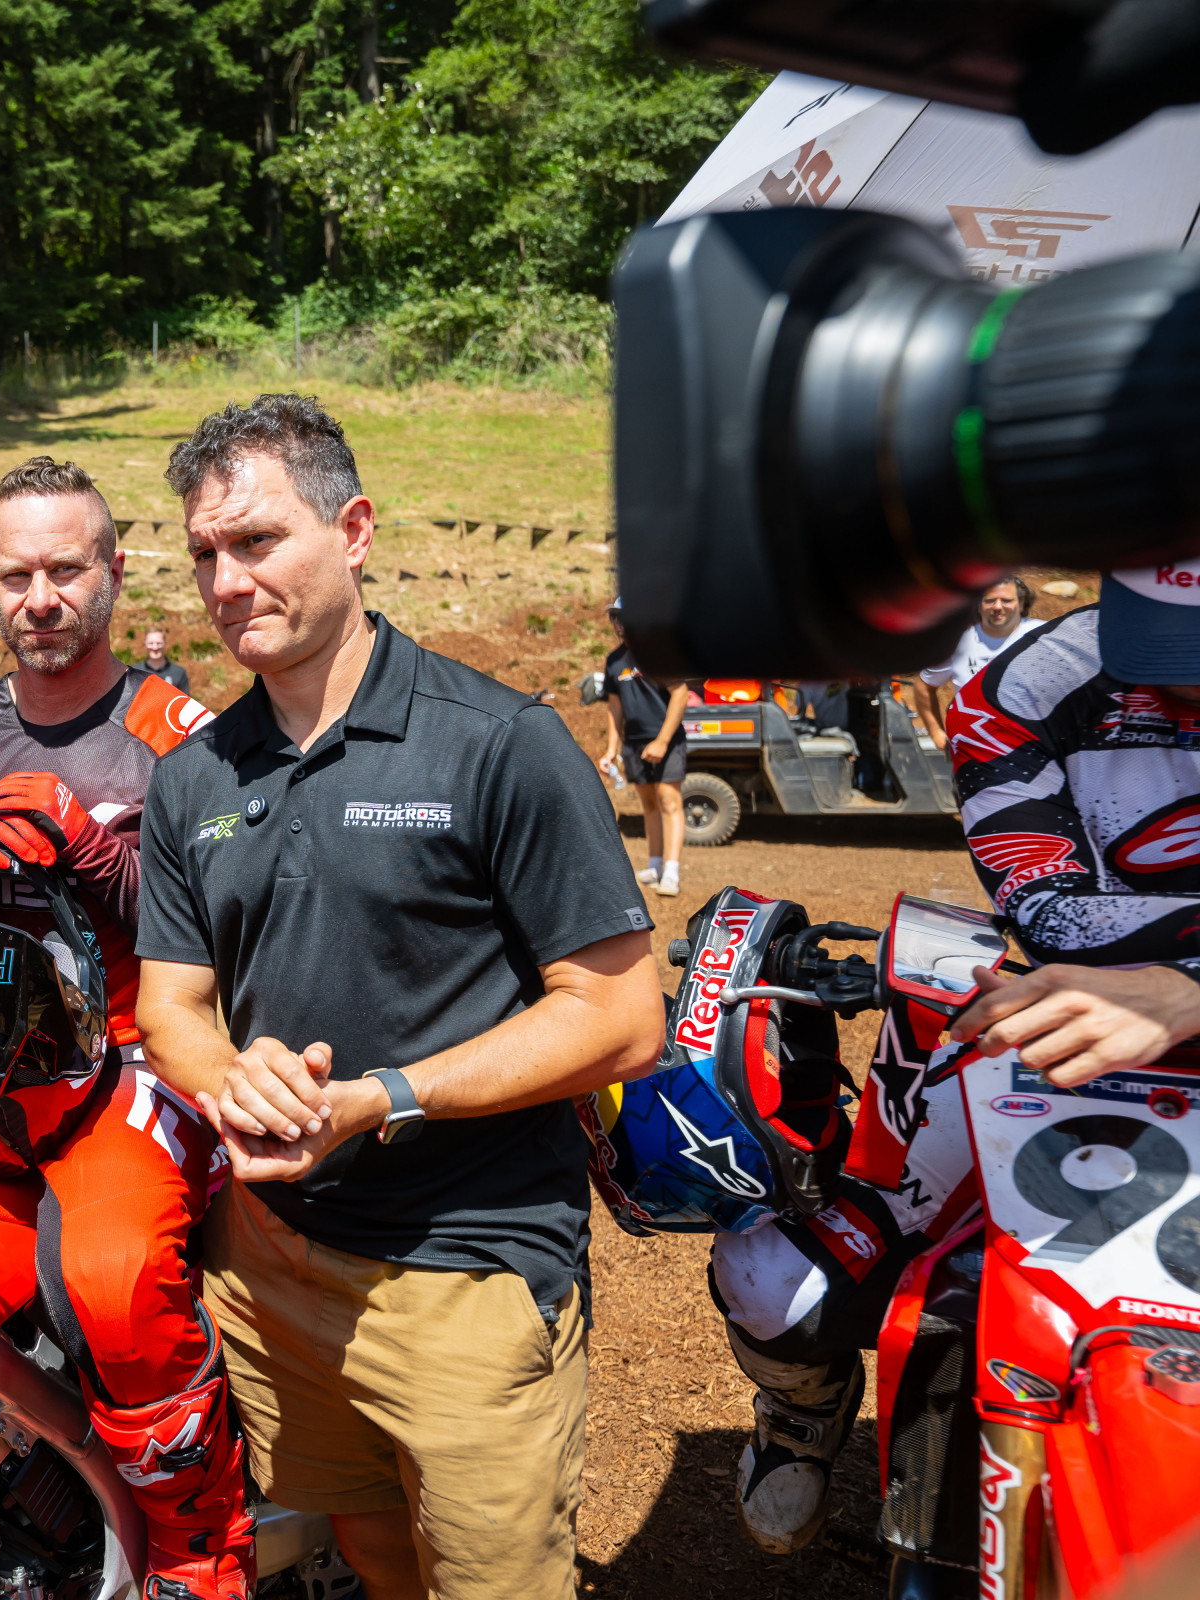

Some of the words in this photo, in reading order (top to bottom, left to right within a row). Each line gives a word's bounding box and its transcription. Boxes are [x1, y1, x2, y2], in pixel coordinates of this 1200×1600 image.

[1155, 563, 1200, 587] Re
[344, 808, 452, 822] MOTOCROSS
[384, 802, 412, 810] PRO
[198, 816, 237, 839] SMX
[343, 820, 452, 829] CHAMPIONSHIP
[697, 908, 757, 972] Bull
[675, 970, 728, 1053] Red
